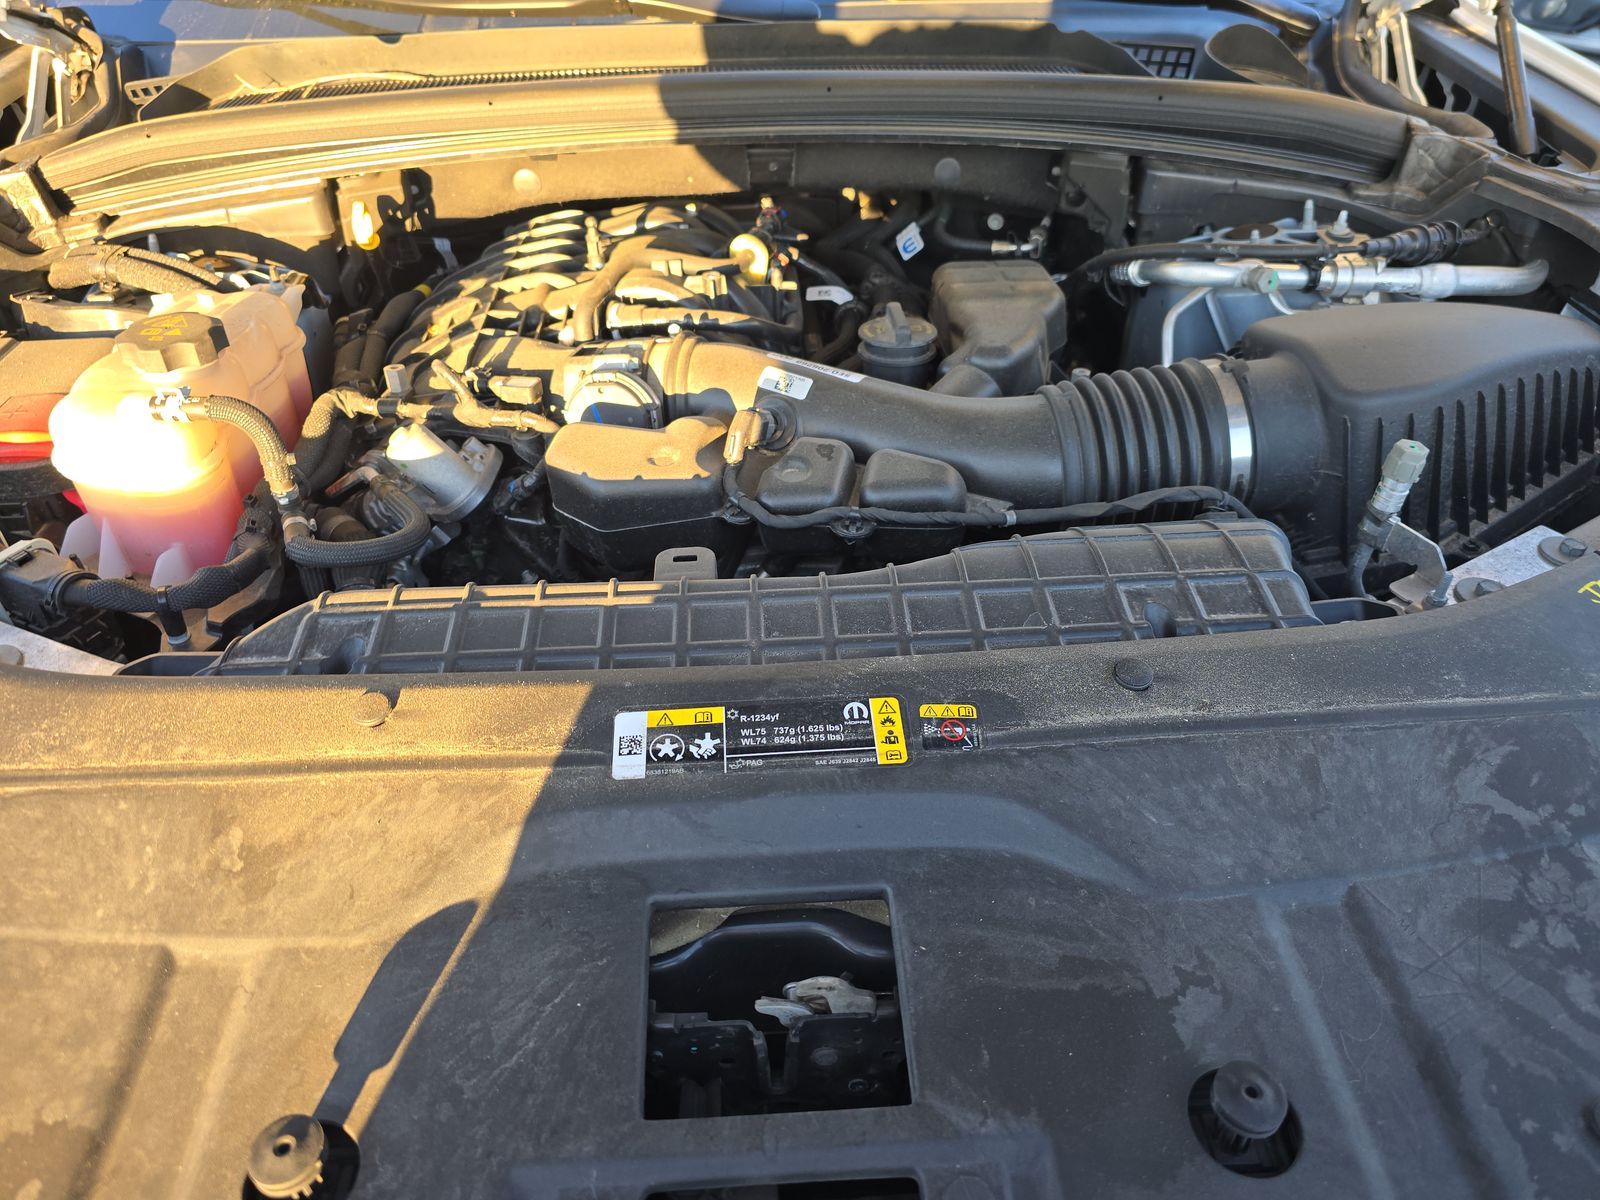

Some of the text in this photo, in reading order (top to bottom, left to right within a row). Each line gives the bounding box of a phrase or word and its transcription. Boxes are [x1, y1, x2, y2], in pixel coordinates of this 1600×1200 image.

[740, 713, 779, 722] R-1234yf
[741, 723, 843, 736] WL75 737g (1.625 lbs)
[774, 736, 796, 745] 624g
[798, 734, 826, 744] (1.375
[827, 733, 844, 742] lbs)
[746, 759, 763, 767] PAG
